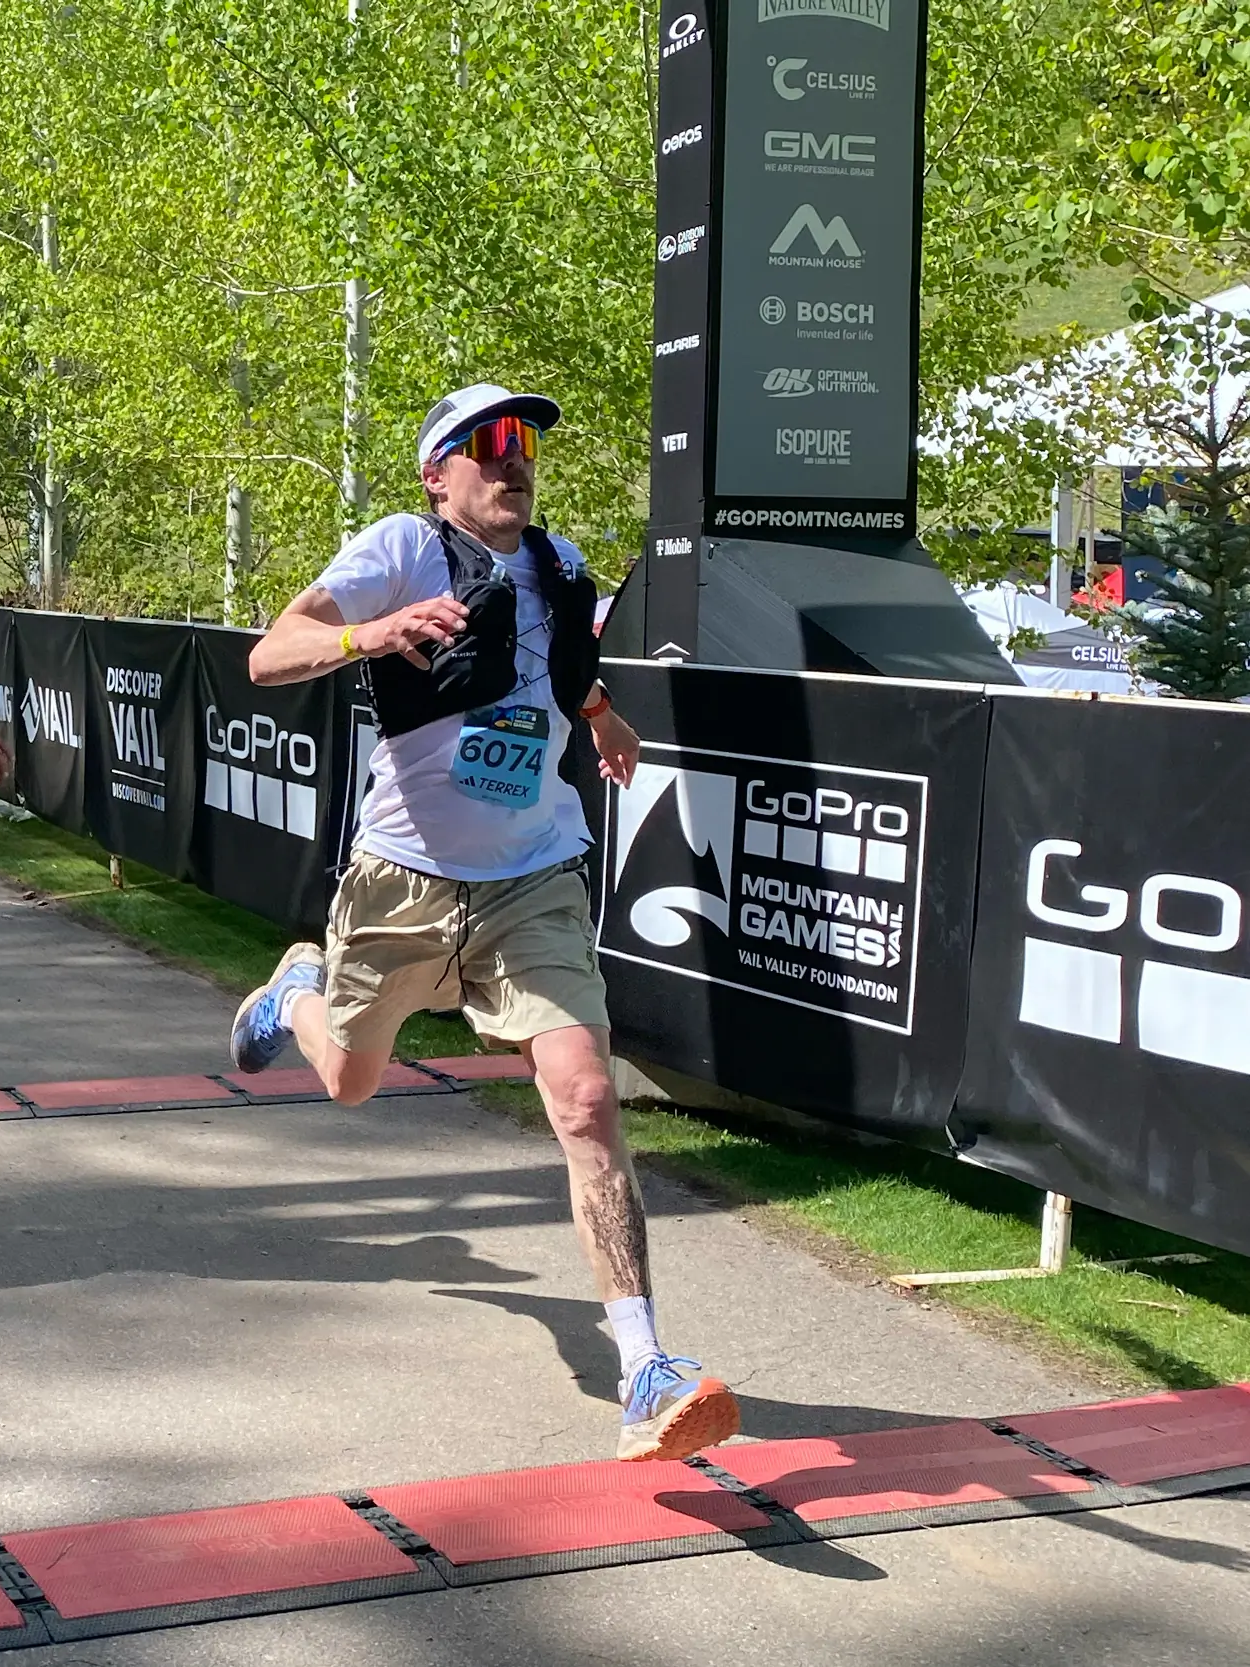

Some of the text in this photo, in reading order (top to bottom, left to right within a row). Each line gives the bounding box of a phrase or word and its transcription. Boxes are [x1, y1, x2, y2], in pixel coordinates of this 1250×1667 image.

[663, 29, 705, 58] OAKLEY
[807, 71, 876, 91] CELSIUS
[764, 130, 876, 162] GMC
[768, 256, 862, 269] MOUNTAIN HOUSE
[797, 301, 874, 324] BOSCH
[656, 334, 700, 358] POLARIS
[796, 328, 874, 342] Invented for life
[817, 369, 869, 382] OPTIMUM
[817, 381, 876, 393] NUTRITION
[661, 432, 688, 453] YETI
[776, 428, 852, 456] ISOPURE
[714, 509, 905, 529] #GOPROMTNGAMES
[106, 666, 163, 700] DISCOVER
[37, 685, 79, 749] VAIL
[108, 700, 166, 772] VAIL
[206, 704, 317, 777] GoPro
[459, 735, 543, 777] 6074
[479, 777, 532, 799] TERREX
[746, 779, 909, 838] GoPro
[741, 873, 889, 926] MOUNTAIN
[739, 903, 887, 967] GAMES
[886, 903, 904, 969] VAIL
[738, 948, 899, 1004] VAIL VALLEY FOUNDATION
